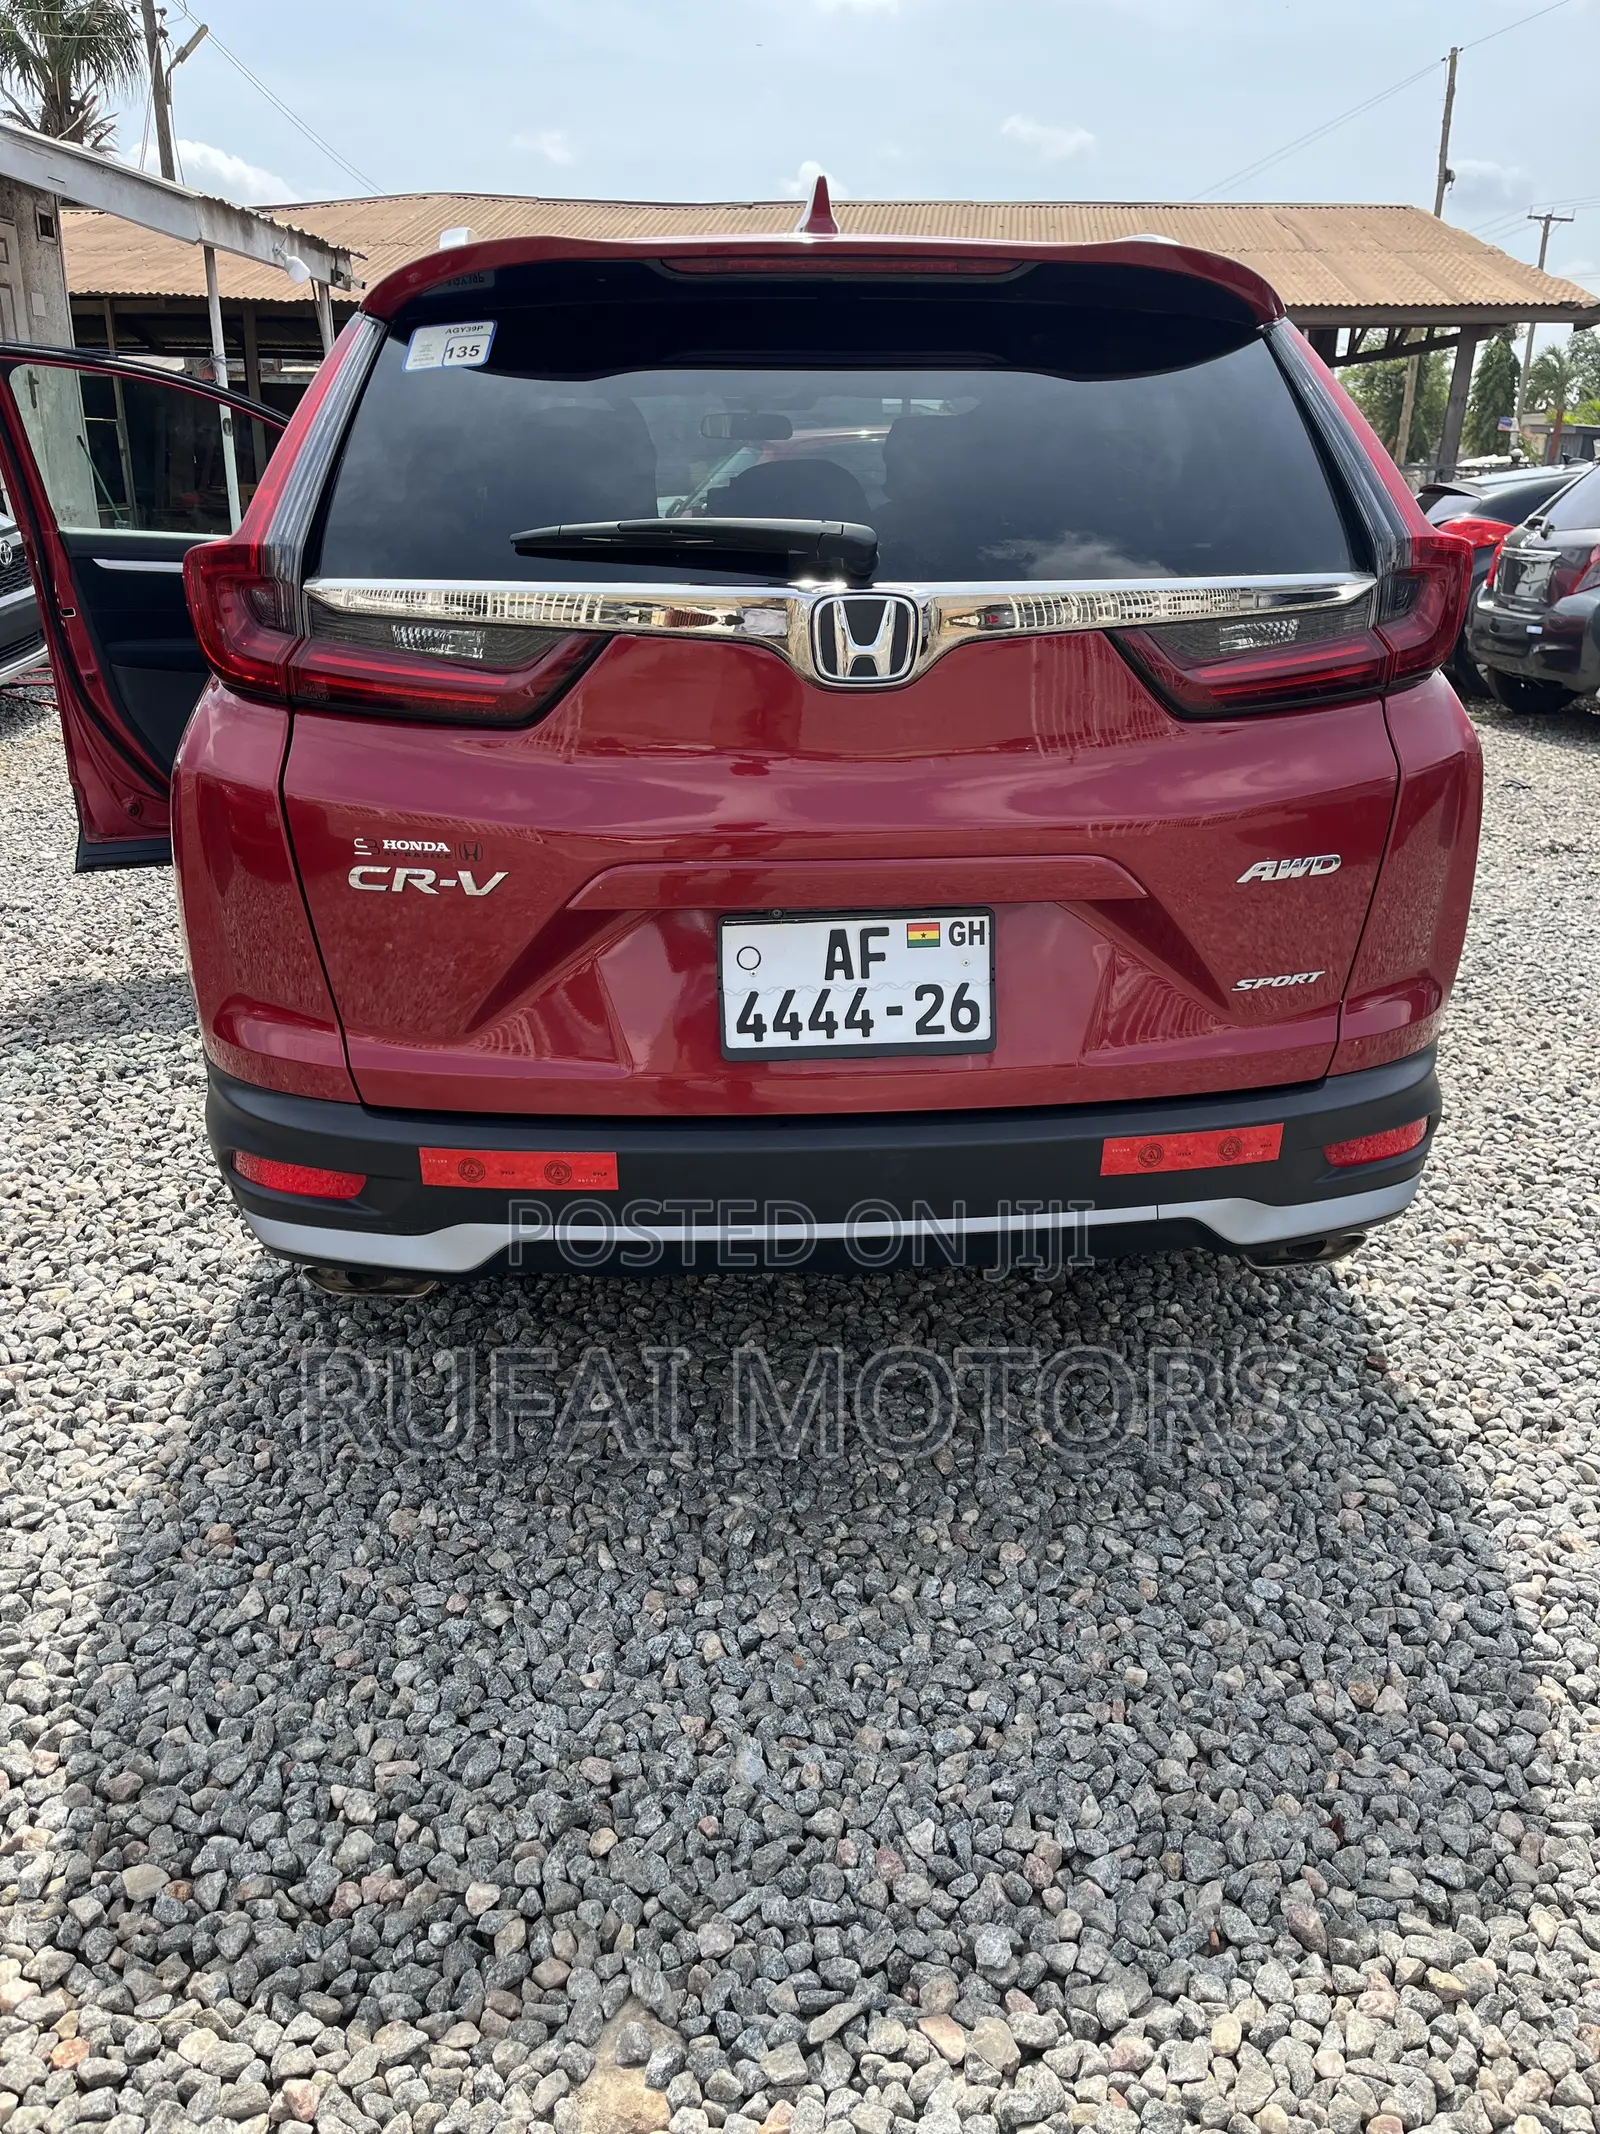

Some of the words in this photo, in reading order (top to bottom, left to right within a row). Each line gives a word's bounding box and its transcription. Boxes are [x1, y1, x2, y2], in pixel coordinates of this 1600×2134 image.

[445, 325, 484, 335] AGY39P
[446, 344, 481, 360] 135
[382, 839, 451, 852] HONDA
[348, 865, 510, 896] CR-V
[1236, 853, 1342, 884] AWD
[824, 926, 890, 981] AF
[948, 920, 986, 947] GH
[1231, 970, 1326, 992] SPORT
[735, 982, 981, 1043] 4444-26
